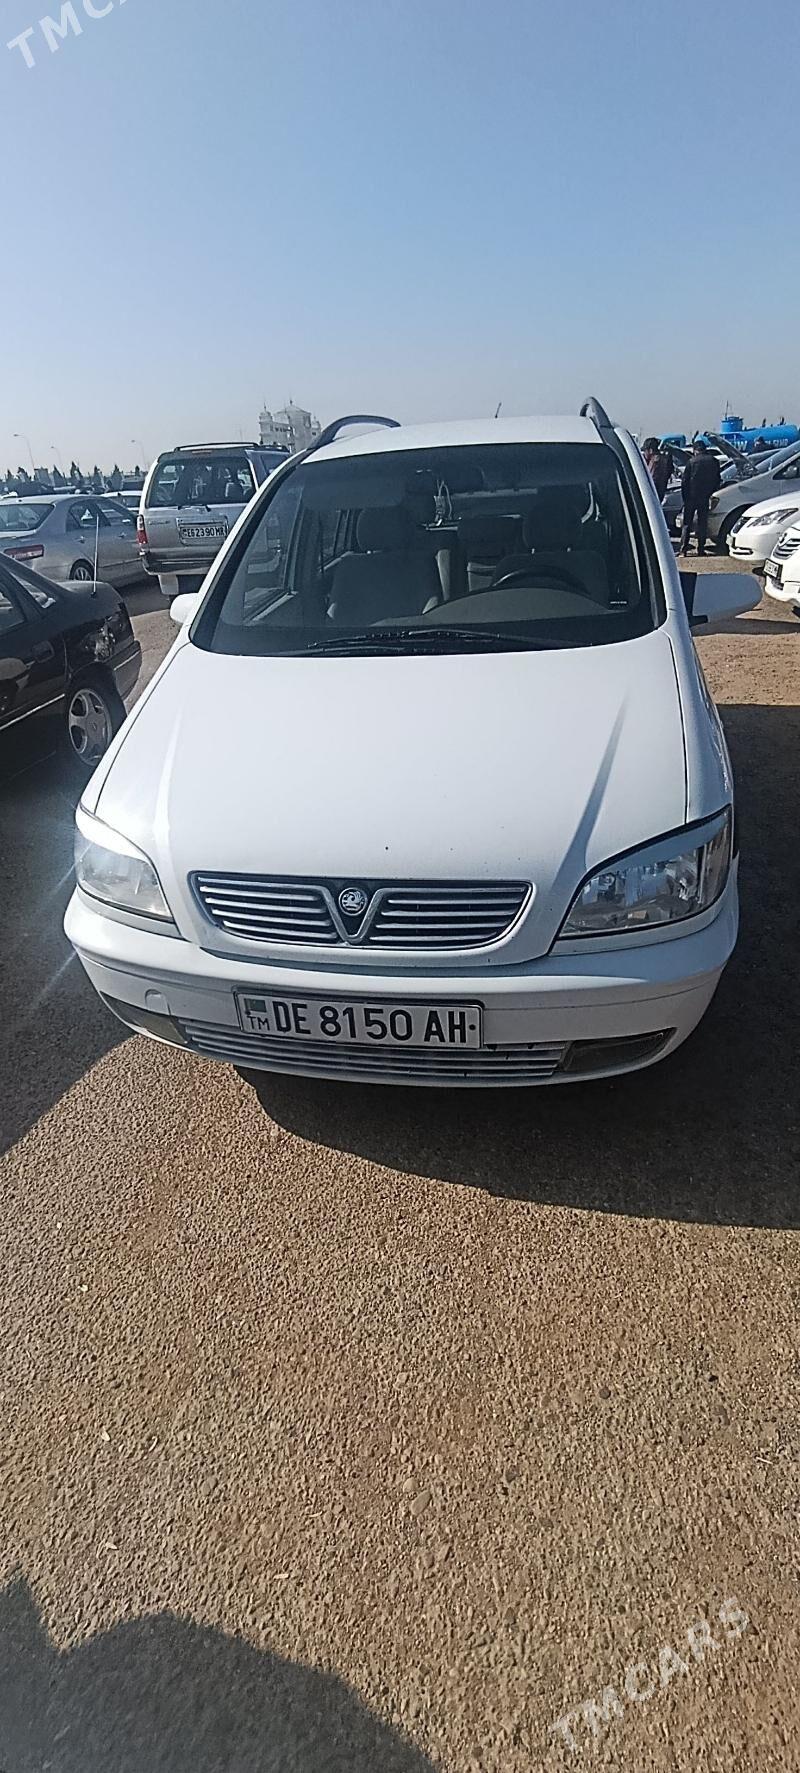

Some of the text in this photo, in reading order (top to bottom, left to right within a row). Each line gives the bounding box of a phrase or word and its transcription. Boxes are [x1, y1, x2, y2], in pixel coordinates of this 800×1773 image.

[246, 1014, 270, 1031] TM
[272, 1001, 467, 1044] DE 8150 AH
